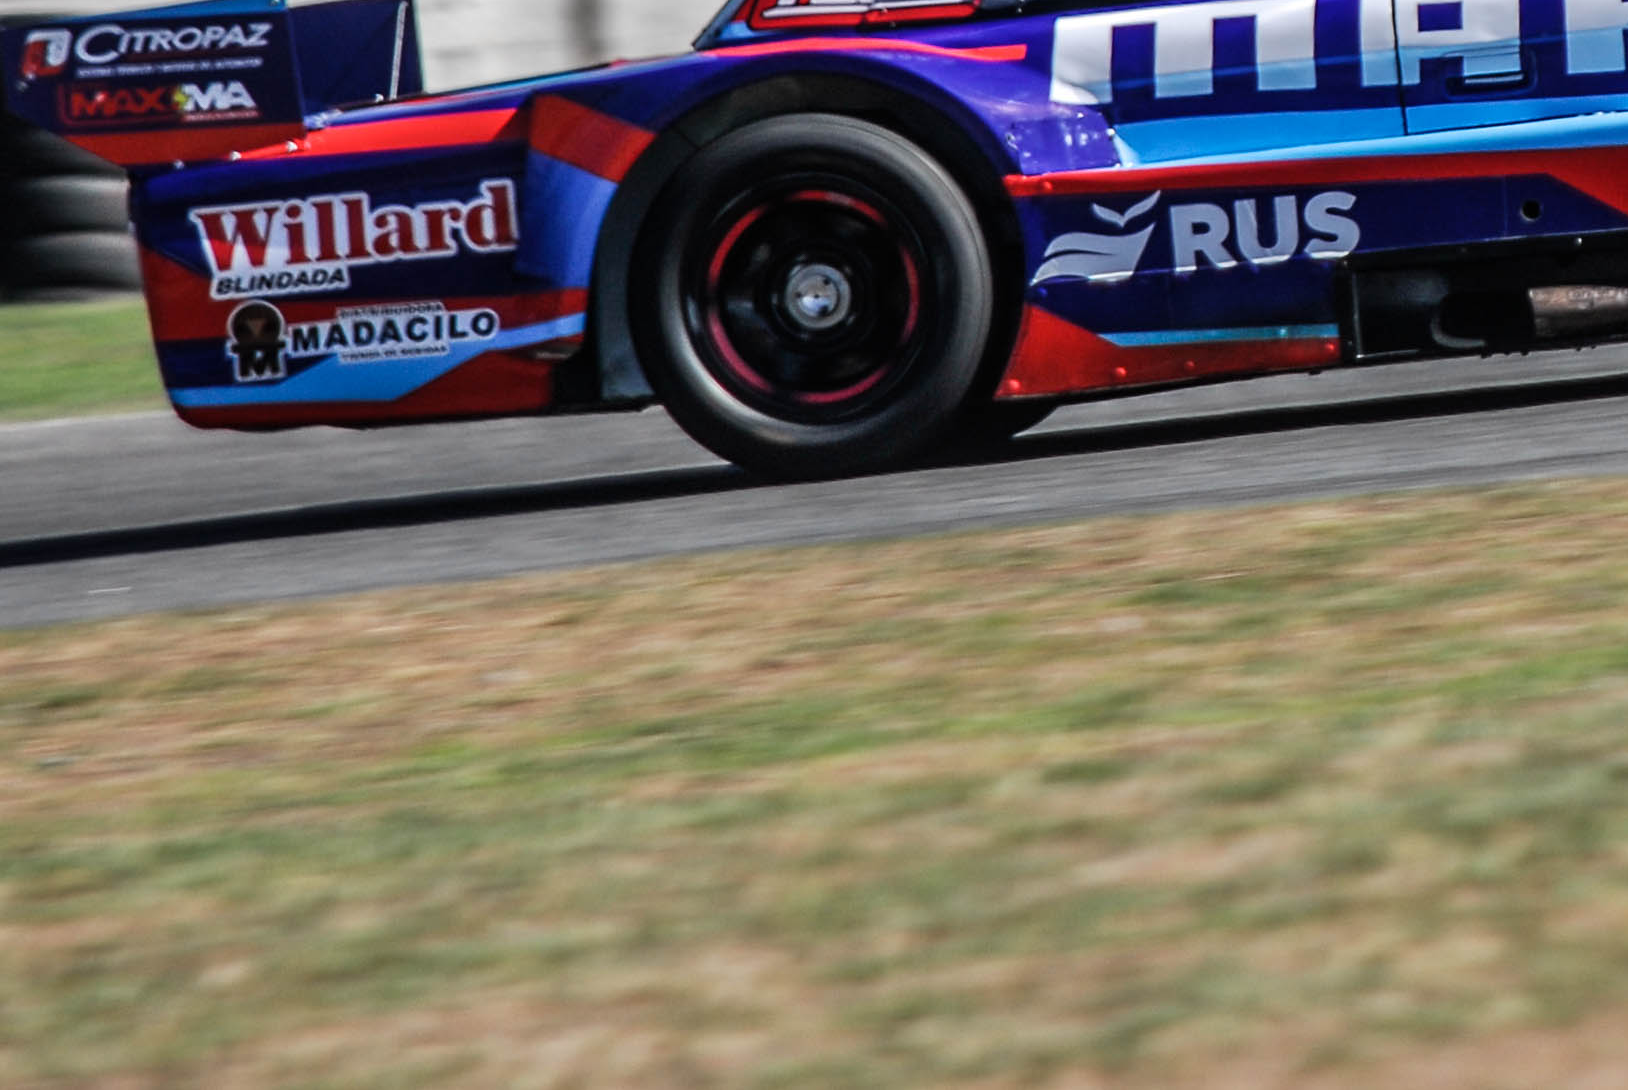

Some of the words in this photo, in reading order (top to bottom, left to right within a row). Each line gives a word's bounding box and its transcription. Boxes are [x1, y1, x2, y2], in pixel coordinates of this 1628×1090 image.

[75, 23, 272, 63] CITROPAZ
[197, 184, 516, 272] Willard
[1170, 191, 1360, 274] RUS
[216, 268, 345, 295] BLINDADA
[293, 312, 495, 352] MADACILO
